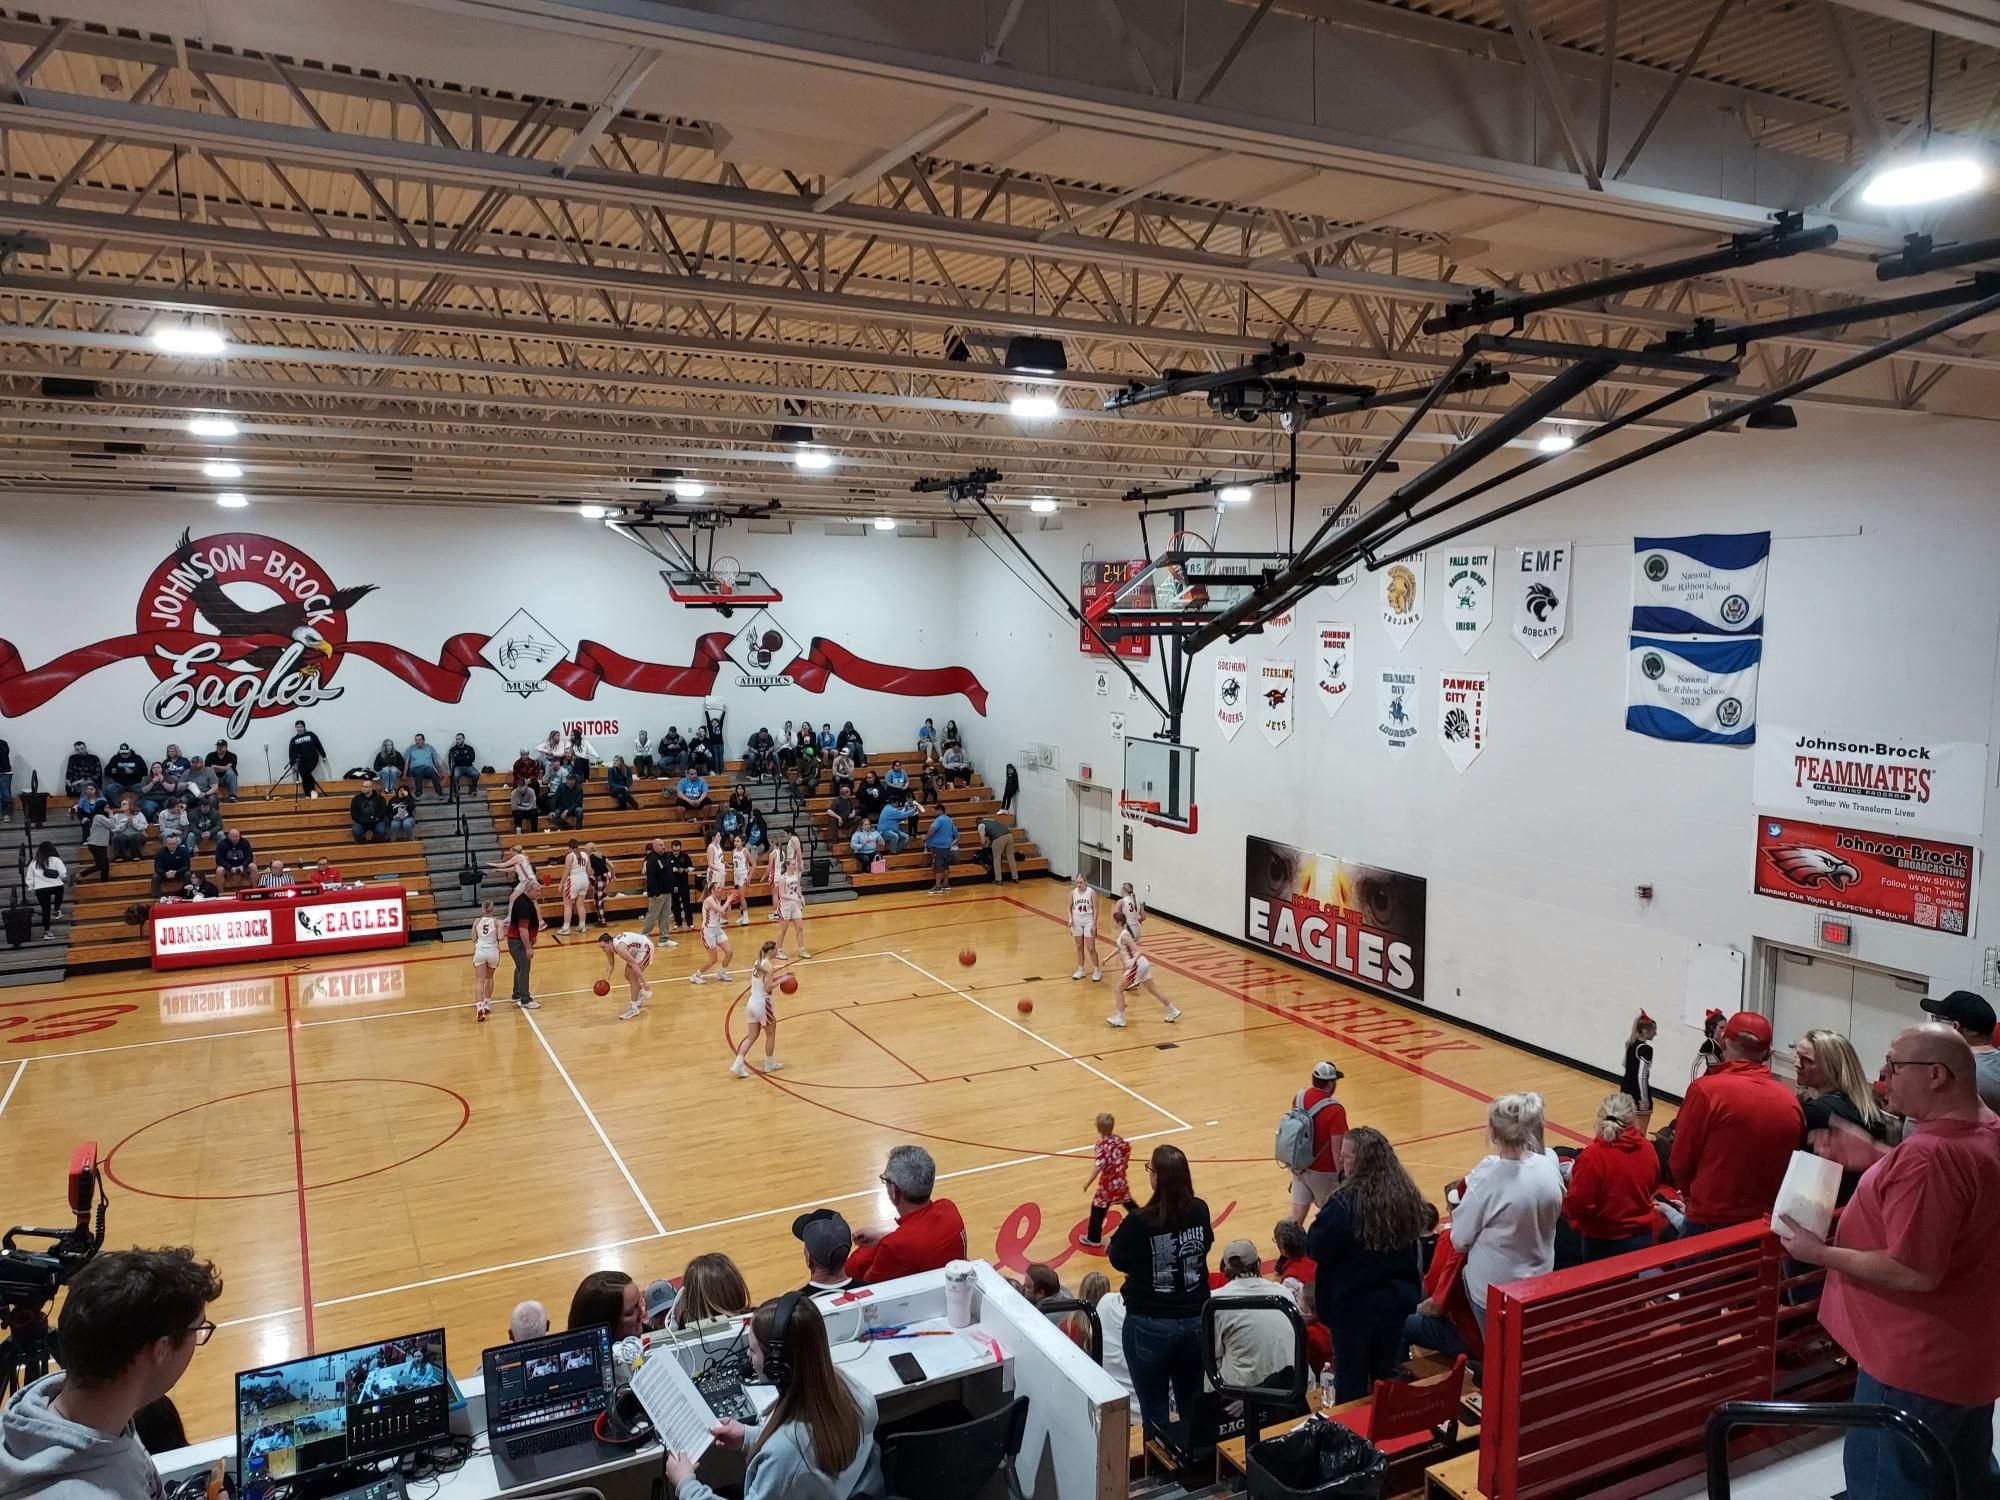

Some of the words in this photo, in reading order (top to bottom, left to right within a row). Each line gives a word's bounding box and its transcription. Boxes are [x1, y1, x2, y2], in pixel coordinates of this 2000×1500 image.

[1322, 505, 1358, 517] NEBSKA
[1449, 556, 1469, 566] FALLS
[1471, 556, 1488, 566] CITY
[1521, 550, 1564, 572] EMF
[1104, 564, 1127, 582] 2:41
[1680, 571, 1711, 580] National
[151, 544, 335, 628] JOHNSON-BROCK
[1084, 587, 1096, 596] HOME
[1662, 583, 1676, 592] Blue
[1678, 582, 1705, 592] Ribbon
[1706, 582, 1731, 592] School
[1685, 592, 1704, 601] 2014
[1384, 613, 1419, 625] TROJANS
[1456, 622, 1476, 631] IRISH
[1522, 626, 1557, 637] BOBCATS
[1320, 630, 1350, 640] JOHNSON
[1323, 640, 1346, 649] BROCK
[1217, 660, 1246, 672] SOUTHERN
[1262, 667, 1293, 679] STERLING
[1678, 675, 1709, 683] National
[506, 681, 543, 691] MUSIC
[739, 676, 790, 686] ATHLETICS
[1319, 680, 1347, 694] EAGLES
[1442, 678, 1485, 691] PAWNEE
[143, 641, 344, 739] Eagles
[1673, 685, 1700, 696] Ribbon
[1445, 692, 1466, 704] CITY
[1680, 697, 1701, 706] 2022
[1218, 709, 1244, 723] RAIDERS
[563, 719, 619, 737] VISITORS
[1266, 720, 1287, 731] JETS
[1796, 737, 1931, 760] Johnson-Brock
[1794, 755, 1931, 804] TEAMMATES
[1815, 784, 1862, 795] MENTORING
[1805, 796, 1836, 808] Together
[1839, 800, 1850, 809] We
[1852, 802, 1892, 815] Transform
[1894, 808, 1915, 818] Lives
[1836, 833, 1967, 868] Johnson-Brock
[1897, 859, 1966, 878] BROADCASTING
[1908, 873, 1966, 890] www.striv.tv
[1881, 877, 1906, 889] Follow
[1909, 883, 1919, 892] us
[1921, 886, 1932, 894] on
[1935, 886, 1966, 899] Twitter!
[1829, 899, 1835, 907] &
[1914, 892, 1965, 909] @jb_eagles
[1078, 905, 1087, 913] 44
[1292, 893, 1321, 913] HOME
[1324, 903, 1340, 917] OF
[1343, 909, 1363, 926] THE
[325, 907, 400, 932] EAGLES
[482, 924, 489, 935] 5
[1249, 896, 1415, 990] EAGLES
[1179, 1225, 1204, 1245] EAGLES
